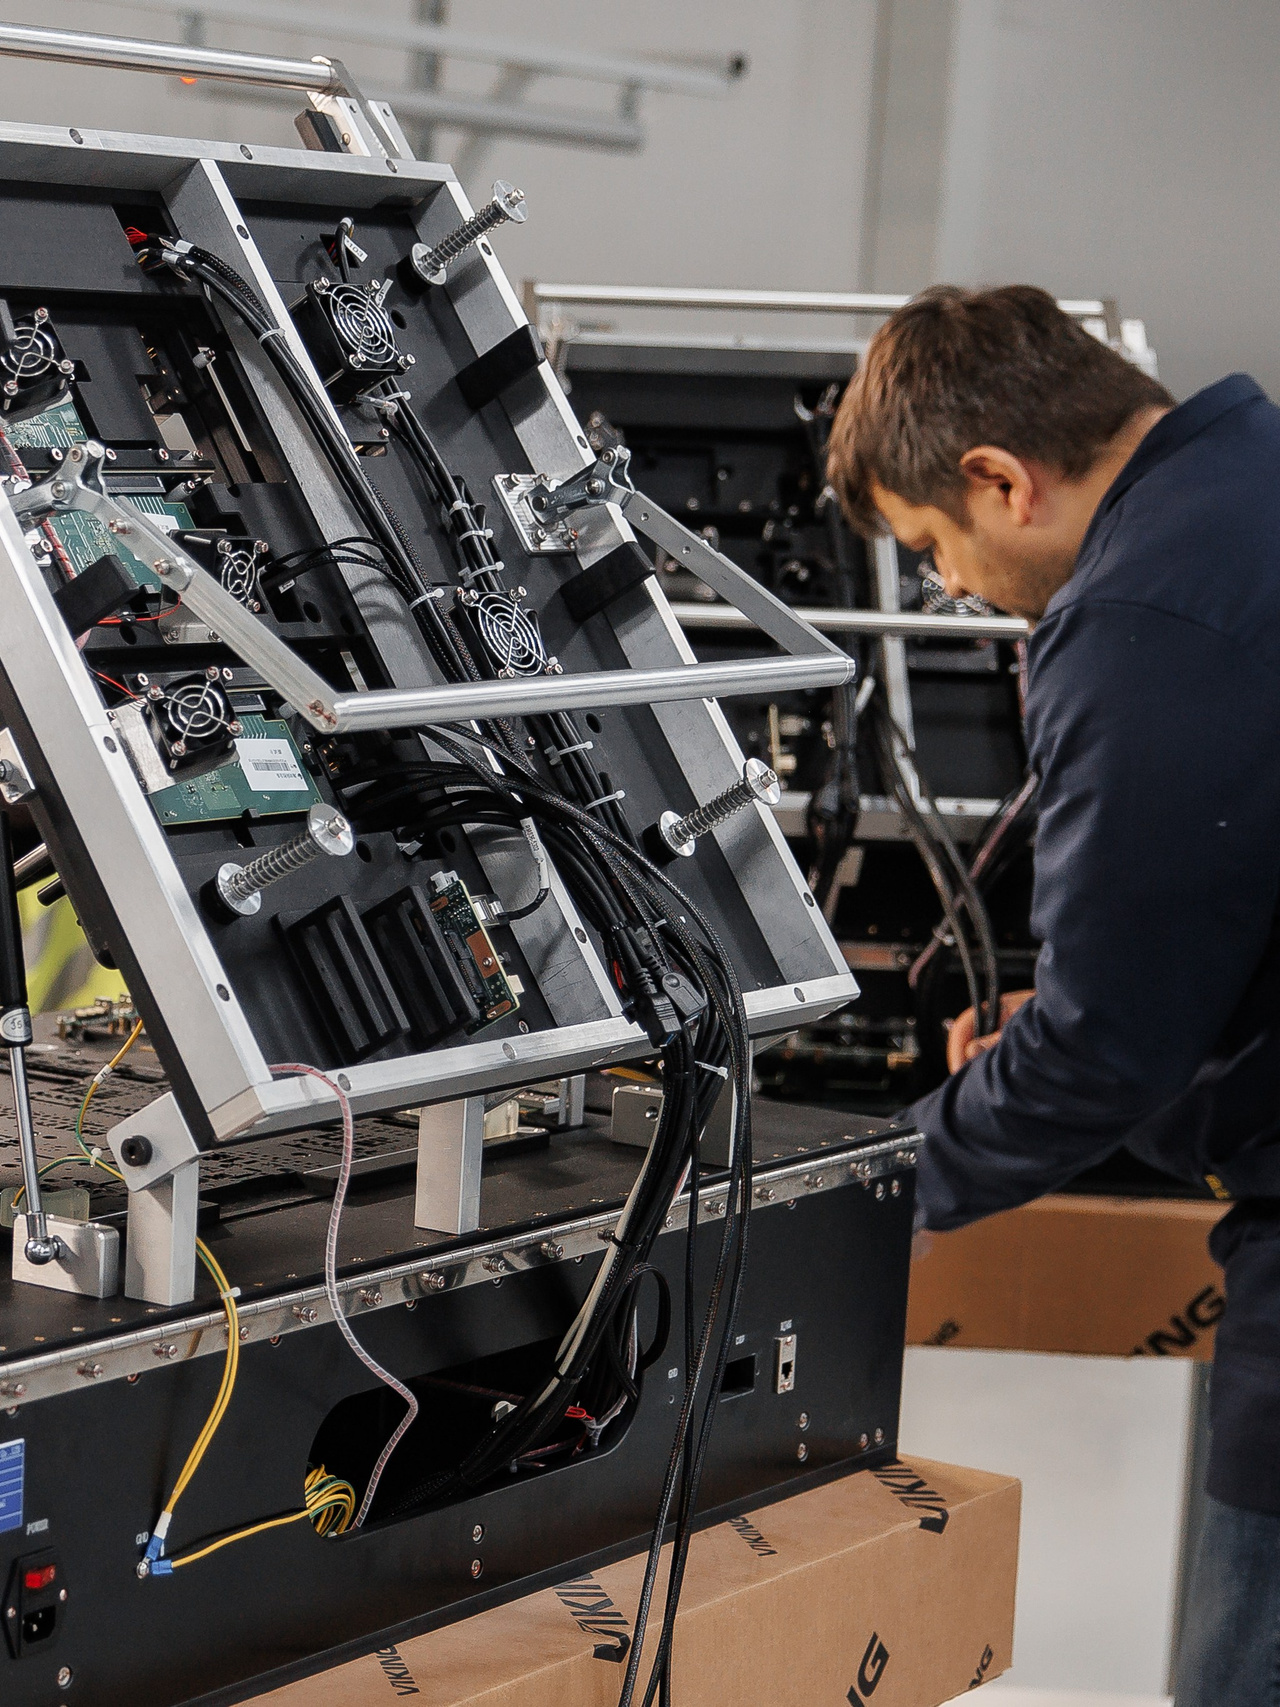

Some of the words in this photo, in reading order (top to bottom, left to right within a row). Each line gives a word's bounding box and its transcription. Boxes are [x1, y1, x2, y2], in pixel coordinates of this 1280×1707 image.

[1133, 1285, 1227, 1356] NG
[727, 1516, 778, 1557] VIKING
[376, 1645, 420, 1696] VIKING
